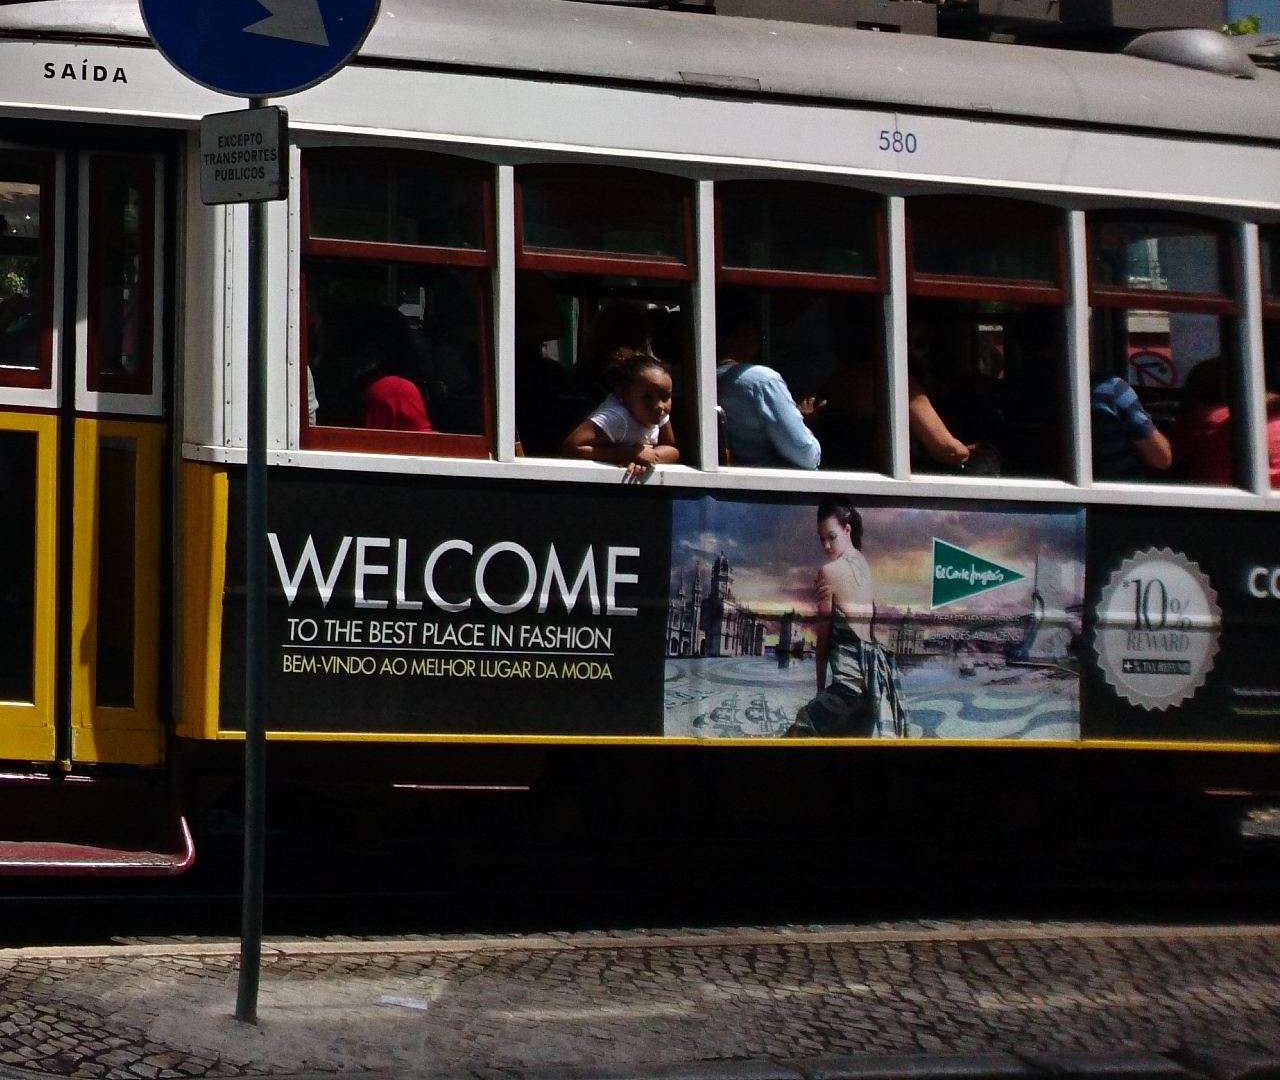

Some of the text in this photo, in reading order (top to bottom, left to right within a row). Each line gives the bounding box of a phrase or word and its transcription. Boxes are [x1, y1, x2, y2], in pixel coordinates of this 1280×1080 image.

[43, 58, 128, 84] SAÍDA
[218, 132, 263, 148] EXCEPTO
[879, 130, 917, 153] 580
[204, 148, 277, 165] TRANSPORTES
[267, 532, 640, 616] WELCOME
[287, 618, 612, 650] TO THE BEST PLACE IN FASHION
[1126, 630, 1190, 653] REWARD
[283, 654, 613, 681] BEM-VINDO AO MELHOR LUGAR DA MODA
